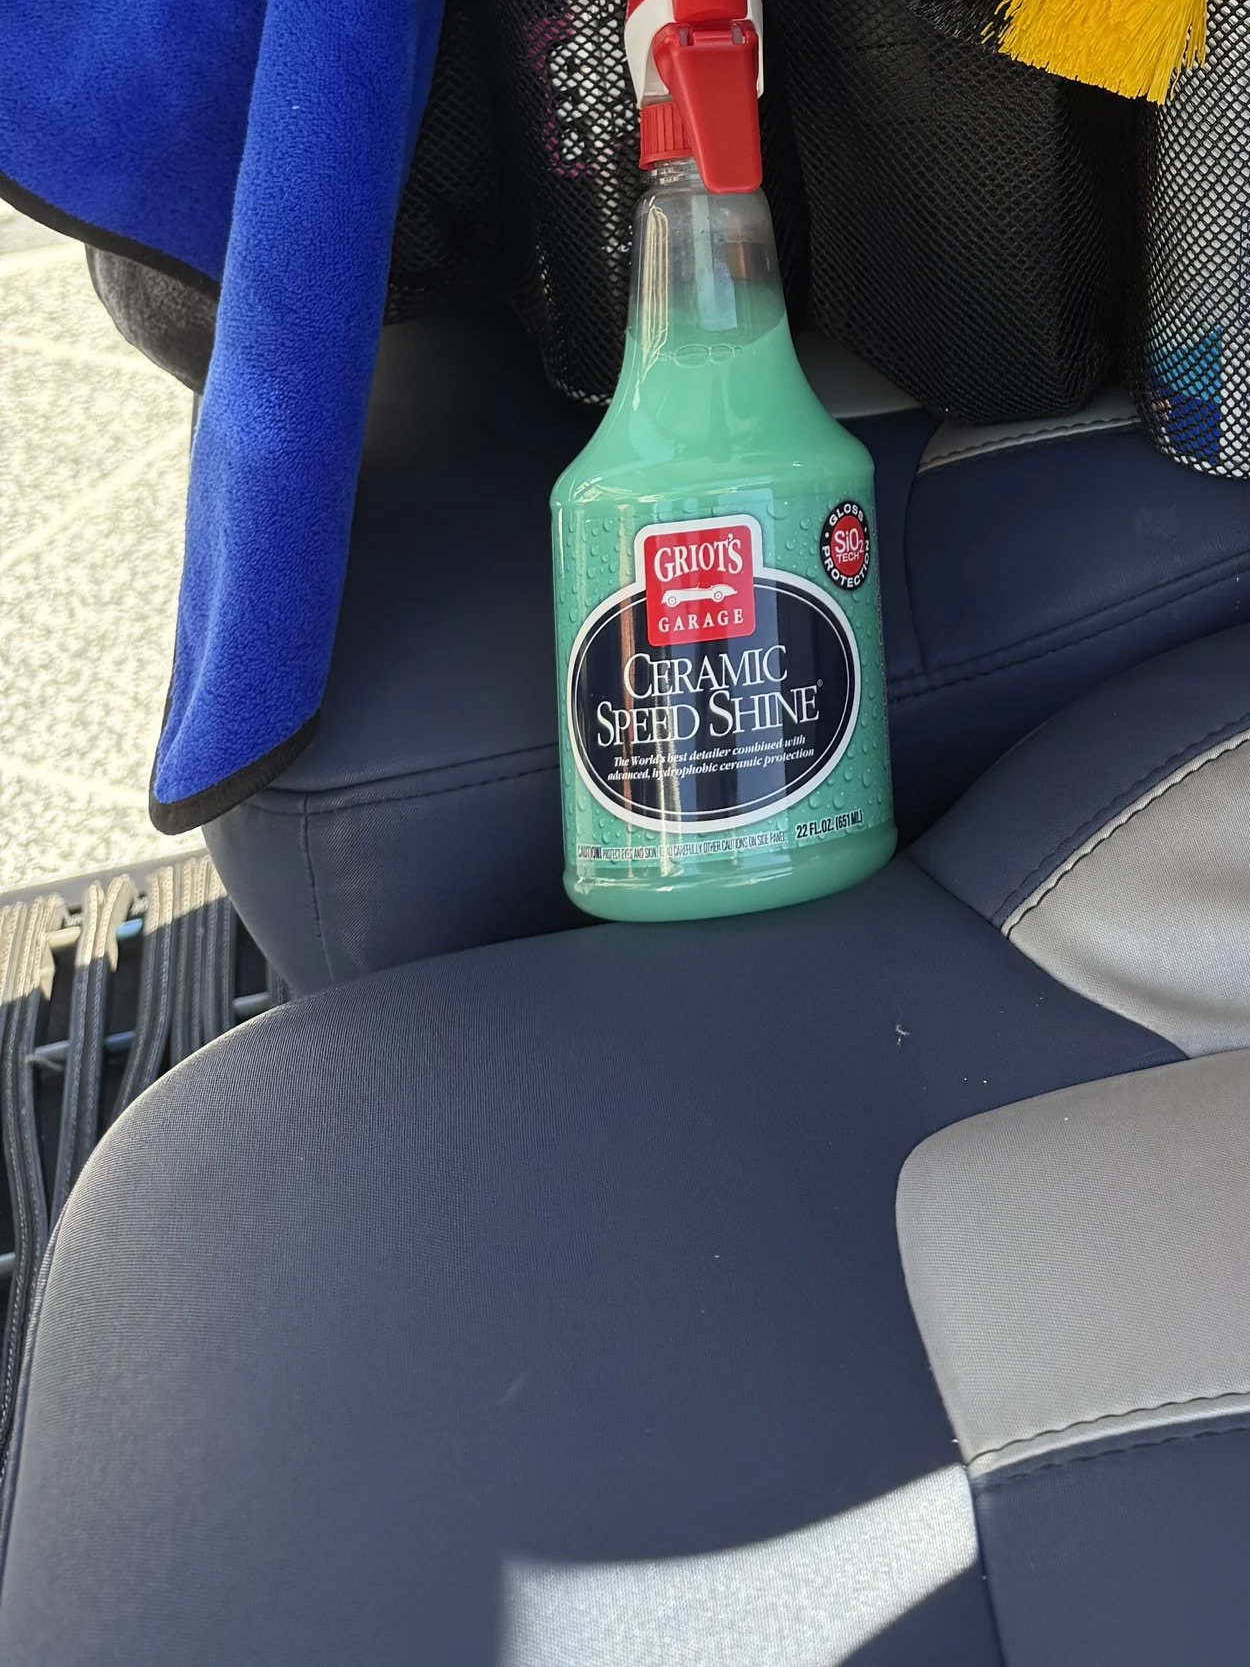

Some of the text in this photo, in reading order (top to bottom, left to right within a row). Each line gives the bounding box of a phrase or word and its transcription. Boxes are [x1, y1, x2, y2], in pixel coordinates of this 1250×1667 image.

[828, 503, 864, 527] GLOSS
[654, 532, 743, 583] GRIOT'S
[822, 539, 870, 588] PROTECTION
[836, 551, 860, 564] TECH
[658, 608, 744, 633] GARAGE
[623, 645, 788, 700] CERAMIC
[596, 700, 700, 748] SPEED
[607, 747, 815, 781] advanced, hydrophobic ceramic protection
[613, 756, 630, 767] The
[667, 750, 687, 763] best
[688, 747, 731, 762] detailer
[732, 737, 783, 756] combined
[784, 734, 806, 748] with
[796, 823, 808, 839] 22
